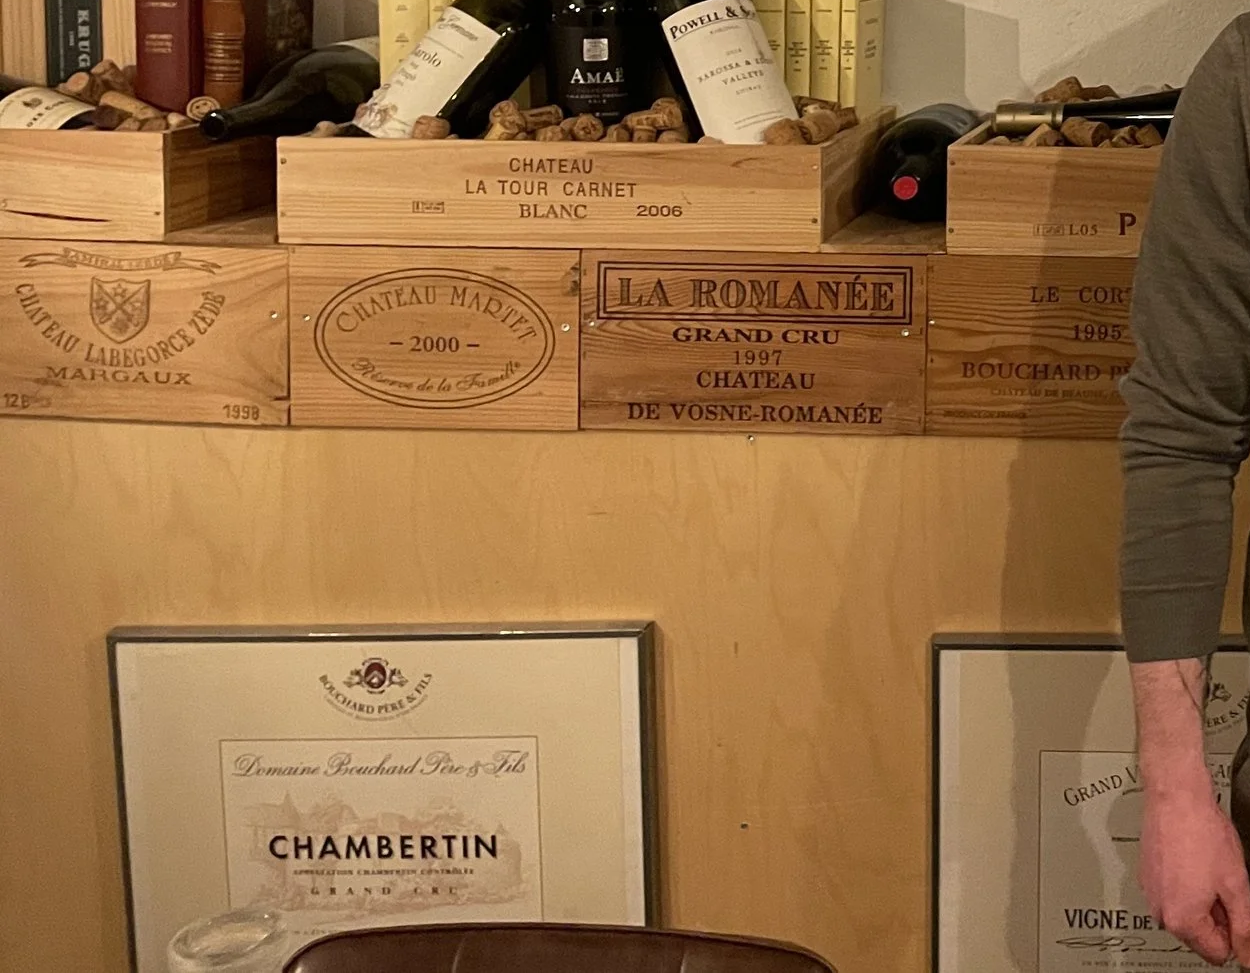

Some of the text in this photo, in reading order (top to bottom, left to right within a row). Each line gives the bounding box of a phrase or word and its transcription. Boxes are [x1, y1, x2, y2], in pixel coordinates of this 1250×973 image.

[670, 12, 723, 40] POWELL
[725, 5, 738, 18] &
[77, 9, 91, 68] KRUG
[509, 157, 593, 174] CHATEAU
[465, 179, 637, 198] LA TOUR CARNET
[519, 203, 683, 219] BLANC 2006
[617, 275, 894, 312] LA ROMANÉE
[1030, 286, 1060, 303] LE
[15, 283, 80, 353] CHATEAU
[336, 285, 537, 340] CHATEAU MARTET
[672, 327, 840, 345] GRAND CRU
[1073, 325, 1122, 341] 1995
[409, 336, 460, 352] 2000
[733, 350, 783, 366] 1997
[46, 366, 192, 385] MARGAUX
[416, 378, 434, 392] de
[437, 378, 451, 393] la
[456, 360, 521, 392] Famille
[697, 371, 815, 390] CHATEAU
[961, 362, 1101, 381] BOUCHARD
[222, 404, 260, 420] 1998
[627, 403, 883, 425] DE VOSNE-ROMANÉE
[319, 674, 374, 714] BOUCHARD
[406, 693, 416, 703] &
[415, 673, 432, 694] FILS
[232, 749, 530, 778] Domaine Bouchard Père & Fils
[1063, 775, 1122, 806] GRAND
[268, 834, 498, 860] CHAMBERTIN
[311, 886, 458, 896] GRAND CRU
[1064, 908, 1153, 930] VIGNE DE
